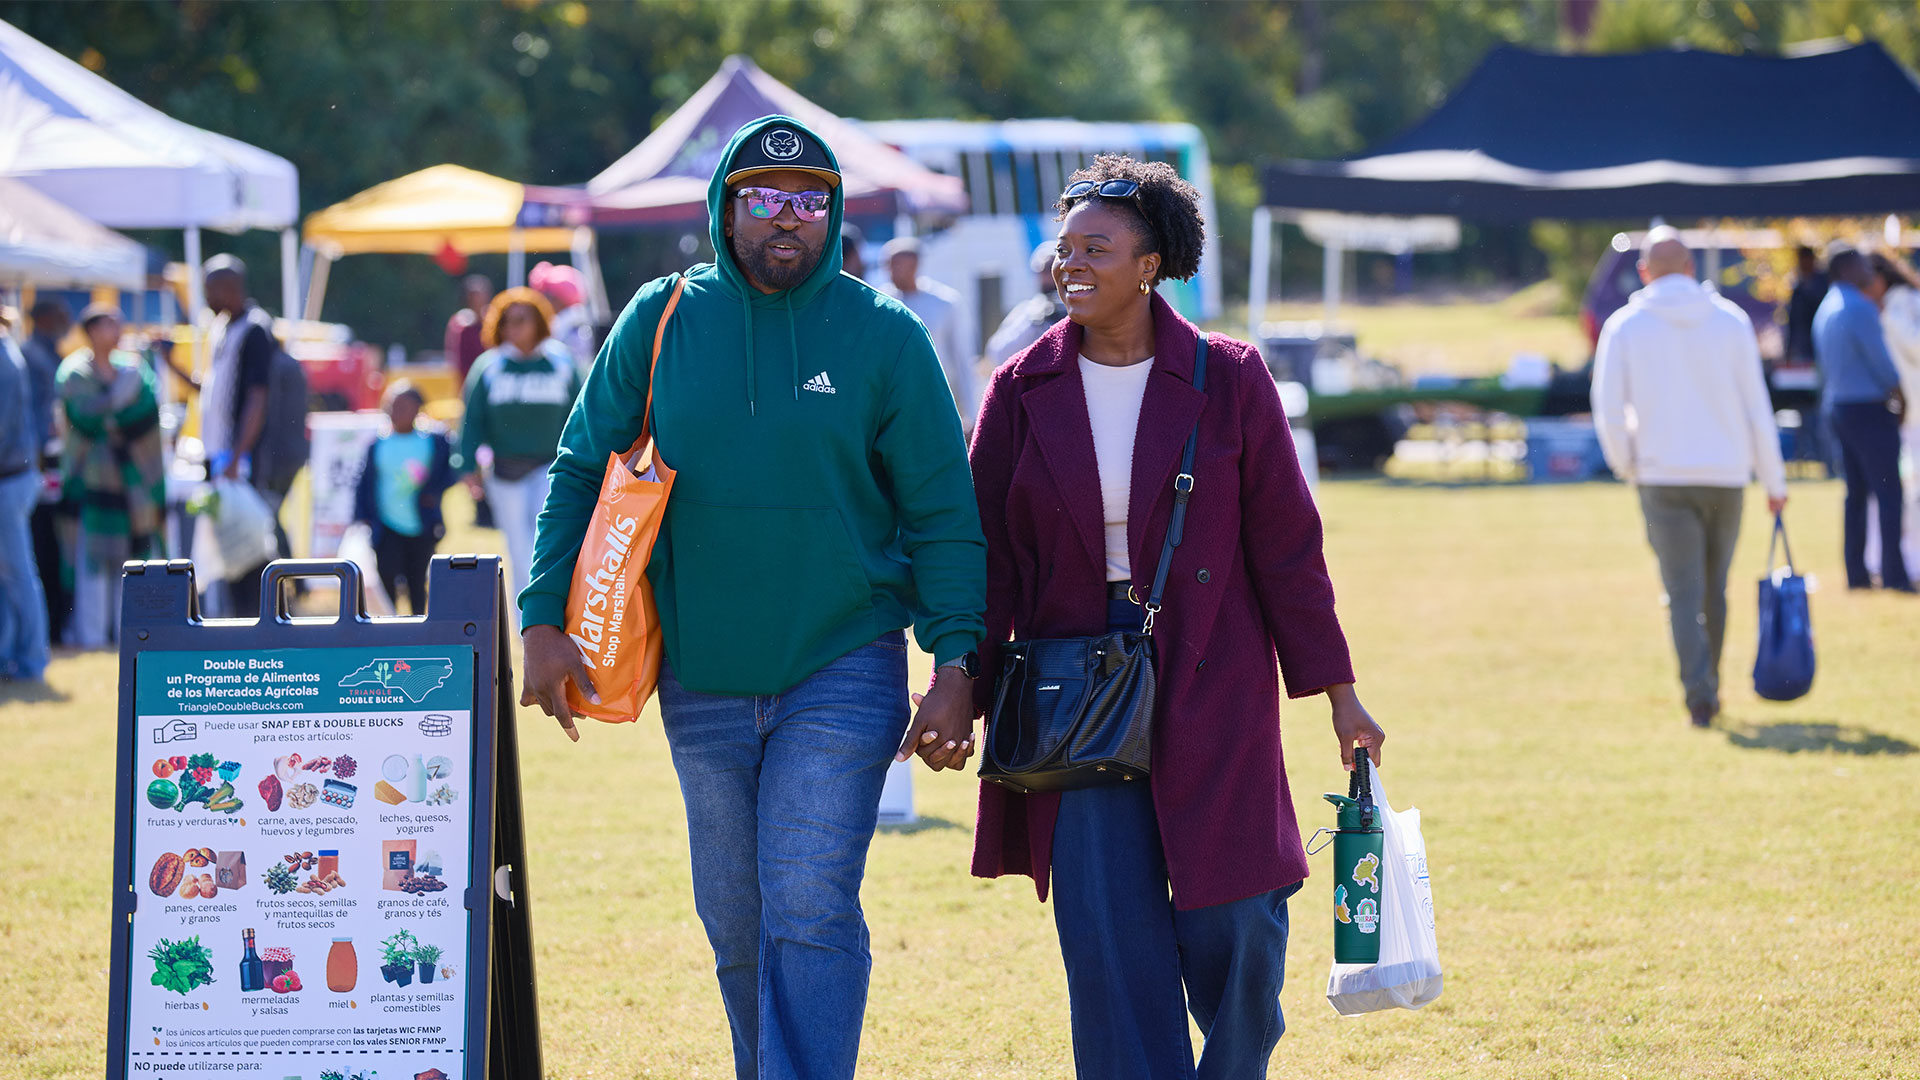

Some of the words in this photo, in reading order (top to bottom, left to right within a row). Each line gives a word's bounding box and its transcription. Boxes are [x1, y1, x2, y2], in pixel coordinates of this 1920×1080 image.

[803, 383, 835, 394] adidas
[602, 635, 622, 667] Shop
[204, 659, 245, 670] Double
[249, 658, 284, 669] Bucks
[167, 676, 181, 684] un
[185, 674, 241, 686] Programa
[244, 673, 259, 683] de
[261, 672, 320, 683] Alimentos
[167, 688, 183, 698] de
[185, 687, 202, 698] los
[205, 686, 262, 697] Mercados
[264, 685, 319, 699] Agrícolas
[339, 696, 373, 704] DOUBLE
[375, 696, 404, 704] BUCKS
[178, 701, 304, 713] TriangleDoubleBucks.com
[204, 721, 236, 730] Puede
[238, 722, 259, 730] usar
[262, 720, 290, 729] SNAP
[292, 720, 311, 728] EBT
[313, 720, 320, 728] &
[323, 719, 366, 728] DOUBLE
[369, 718, 404, 727] BUCKS
[254, 735, 274, 744] para
[278, 734, 305, 742] estos
[307, 732, 353, 741] artículos:
[147, 818, 175, 826] frutas
[177, 819, 183, 828] y
[185, 817, 227, 826] verduras
[258, 818, 287, 826] carne,
[289, 817, 313, 825] aves,
[316, 815, 358, 826] pescado,
[380, 814, 413, 823] leches,
[415, 815, 451, 824] quesos,
[261, 827, 295, 836] huevos
[297, 829, 303, 837] y
[305, 826, 355, 837] legumbres
[396, 826, 434, 835] yogures
[165, 905, 195, 914] panes,
[198, 903, 237, 912] cereales
[256, 899, 285, 908] frutos
[287, 900, 317, 908] secos,
[319, 898, 357, 907] semillas
[377, 900, 410, 909] granos
[412, 898, 424, 907] de
[426, 897, 449, 907] café,
[180, 916, 187, 925] y
[188, 915, 221, 925] granos
[265, 912, 270, 920] y
[273, 909, 334, 920] mantequillas
[336, 909, 348, 918] de
[384, 910, 417, 920] granos
[419, 911, 425, 919] y
[427, 909, 442, 917] tés
[277, 920, 306, 929] frutos
[308, 921, 335, 929] secos
[242, 995, 300, 1004] mermeladas
[329, 1000, 349, 1008] miel
[370, 993, 406, 1004] plantas
[408, 995, 414, 1004] y
[416, 993, 454, 1002] semillas
[165, 1001, 200, 1010] hierbas
[383, 1003, 441, 1013] comestibles
[252, 1008, 258, 1017] y
[260, 1006, 288, 1015] salsas
[179, 1028, 206, 1036] únicos
[207, 1028, 242, 1036] artículos
[243, 1029, 259, 1037] que
[260, 1028, 291, 1037] pueden
[366, 1027, 398, 1036] tarjetas
[399, 1026, 415, 1034] WIC
[207, 1039, 242, 1047] artículos
[260, 1039, 290, 1048] pueden
[134, 1062, 150, 1071] NO
[153, 1061, 186, 1073] puede
[188, 1061, 234, 1071] utilizarse
[237, 1063, 262, 1072] para:
